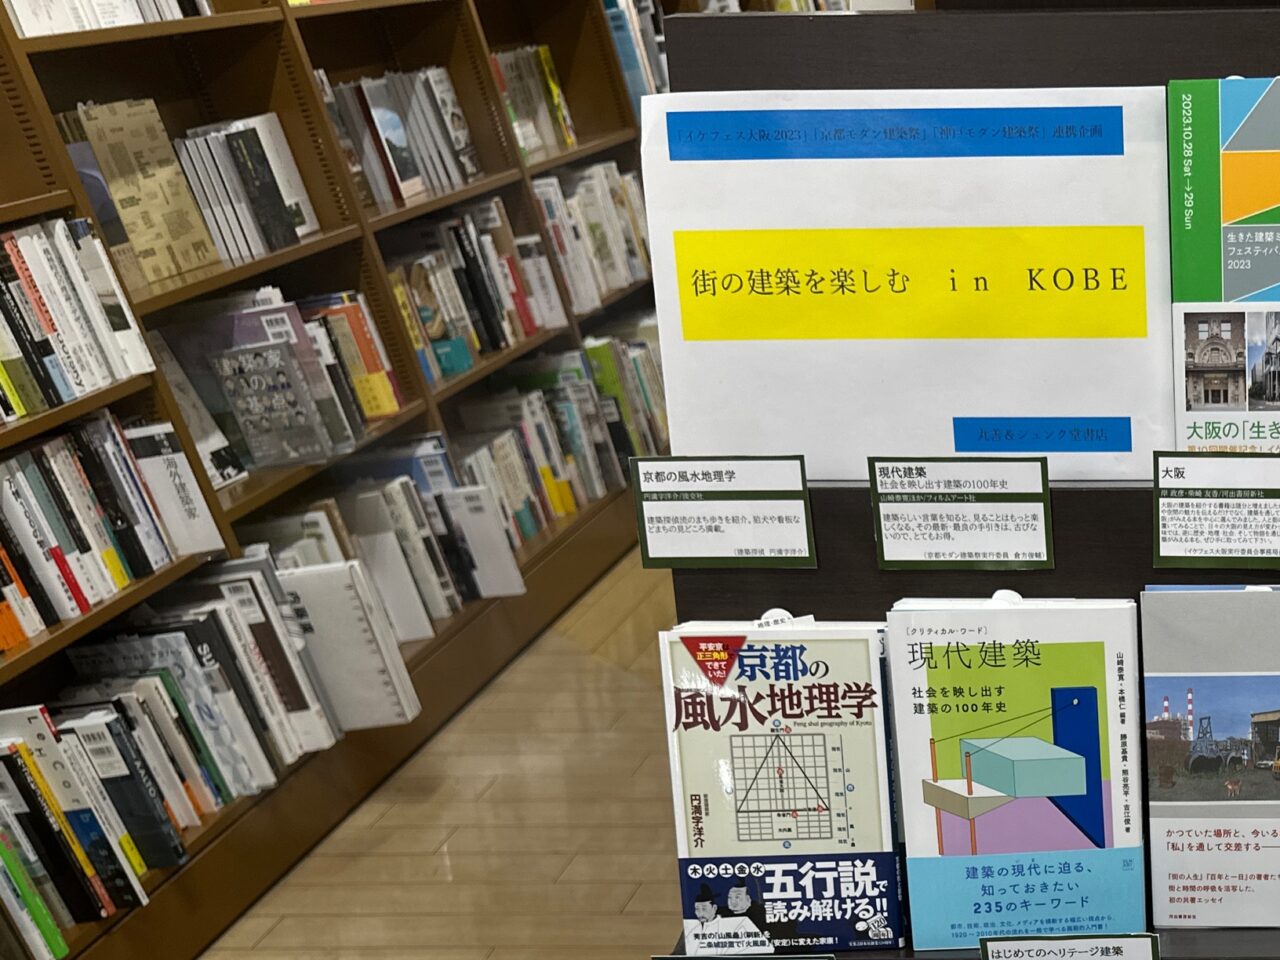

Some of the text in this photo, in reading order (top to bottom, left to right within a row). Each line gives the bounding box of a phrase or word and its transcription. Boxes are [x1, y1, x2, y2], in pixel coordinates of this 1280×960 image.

[1227, 259, 1251, 269] 2023
[692, 268, 910, 296] 街の建築を楽しむ
[1027, 267, 1129, 292] KOBE
[642, 470, 736, 483] 京都の風水地理学
[878, 466, 927, 479] 現代建築
[1161, 466, 1186, 480] 大阪
[734, 643, 829, 681] 京都の
[907, 638, 1042, 671] 現代建築
[911, 685, 1006, 699] 社会を映し出す
[672, 681, 878, 733] 風水地理学
[913, 701, 1007, 715] 建築の100年史
[762, 858, 888, 900] 五行説で
[981, 881, 1079, 897] 知っておきたい
[972, 895, 1090, 914] 235のキーワード
[990, 945, 1124, 960] はじめてのヘリテージ建築
